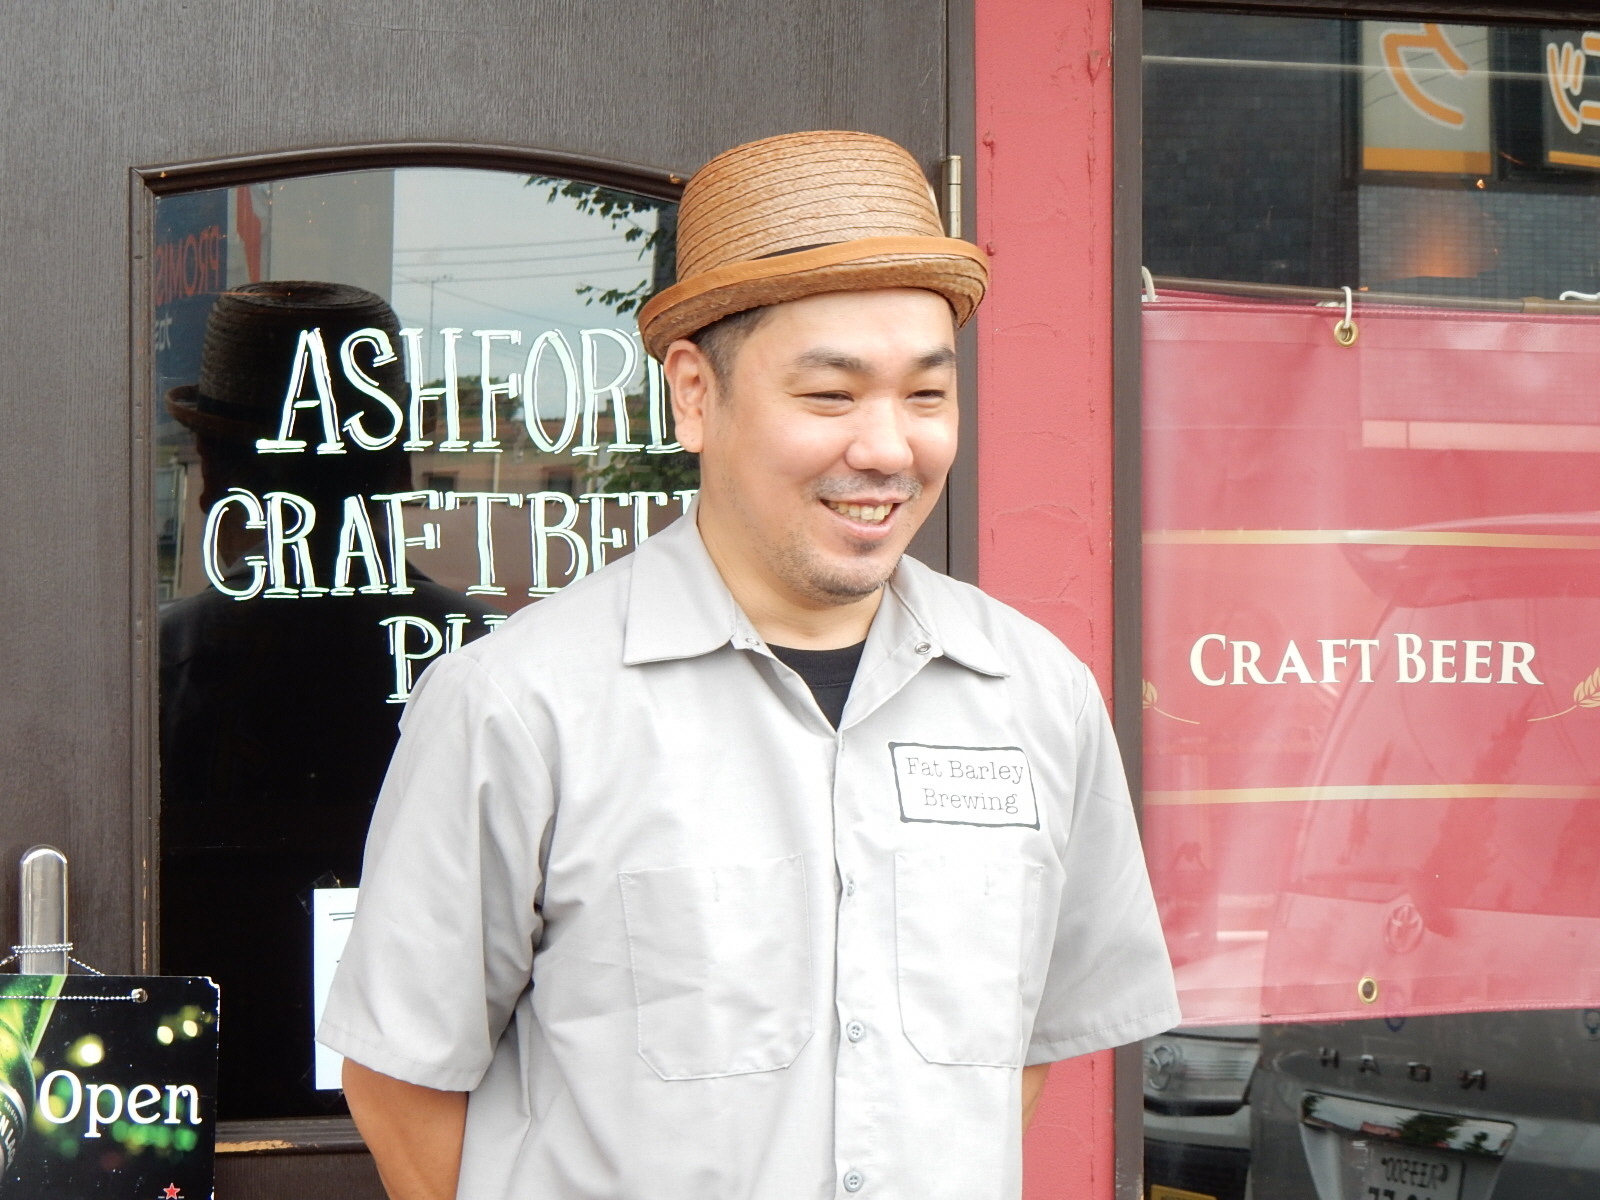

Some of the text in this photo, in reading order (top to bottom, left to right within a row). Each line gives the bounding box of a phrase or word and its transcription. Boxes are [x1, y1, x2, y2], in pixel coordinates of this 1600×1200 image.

[905, 757, 1023, 785] Fat Barley
[922, 788, 1019, 815] Brewing
[40, 1069, 203, 1138] Open
